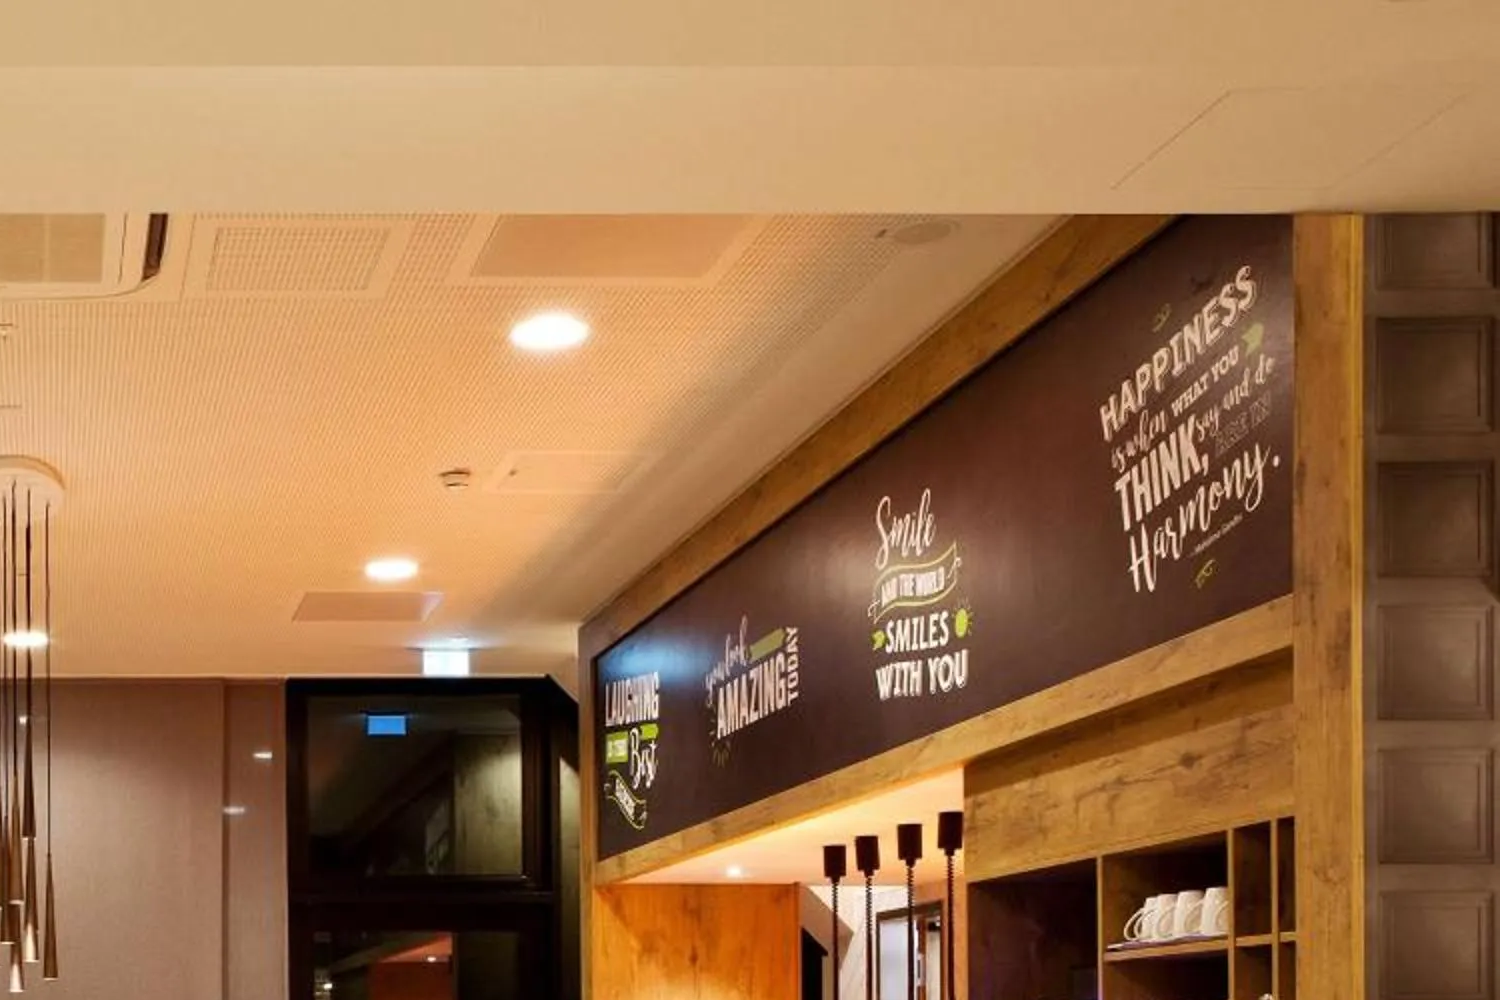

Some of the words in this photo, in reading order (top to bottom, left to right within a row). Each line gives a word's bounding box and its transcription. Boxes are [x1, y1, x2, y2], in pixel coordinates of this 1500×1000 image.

[1100, 265, 1257, 441] HAPPINESS
[1171, 372, 1209, 417] WHAT
[1211, 345, 1239, 382] YOU
[1115, 413, 1209, 532] THINK,
[1223, 367, 1250, 411] and
[875, 488, 937, 570] Smile
[1129, 442, 1280, 593] Harmony.
[876, 660, 922, 700] WITH
[928, 649, 969, 695] YOU
[885, 611, 949, 654] SMILES
[717, 652, 787, 740] AMAZING
[786, 627, 799, 707] TODAY
